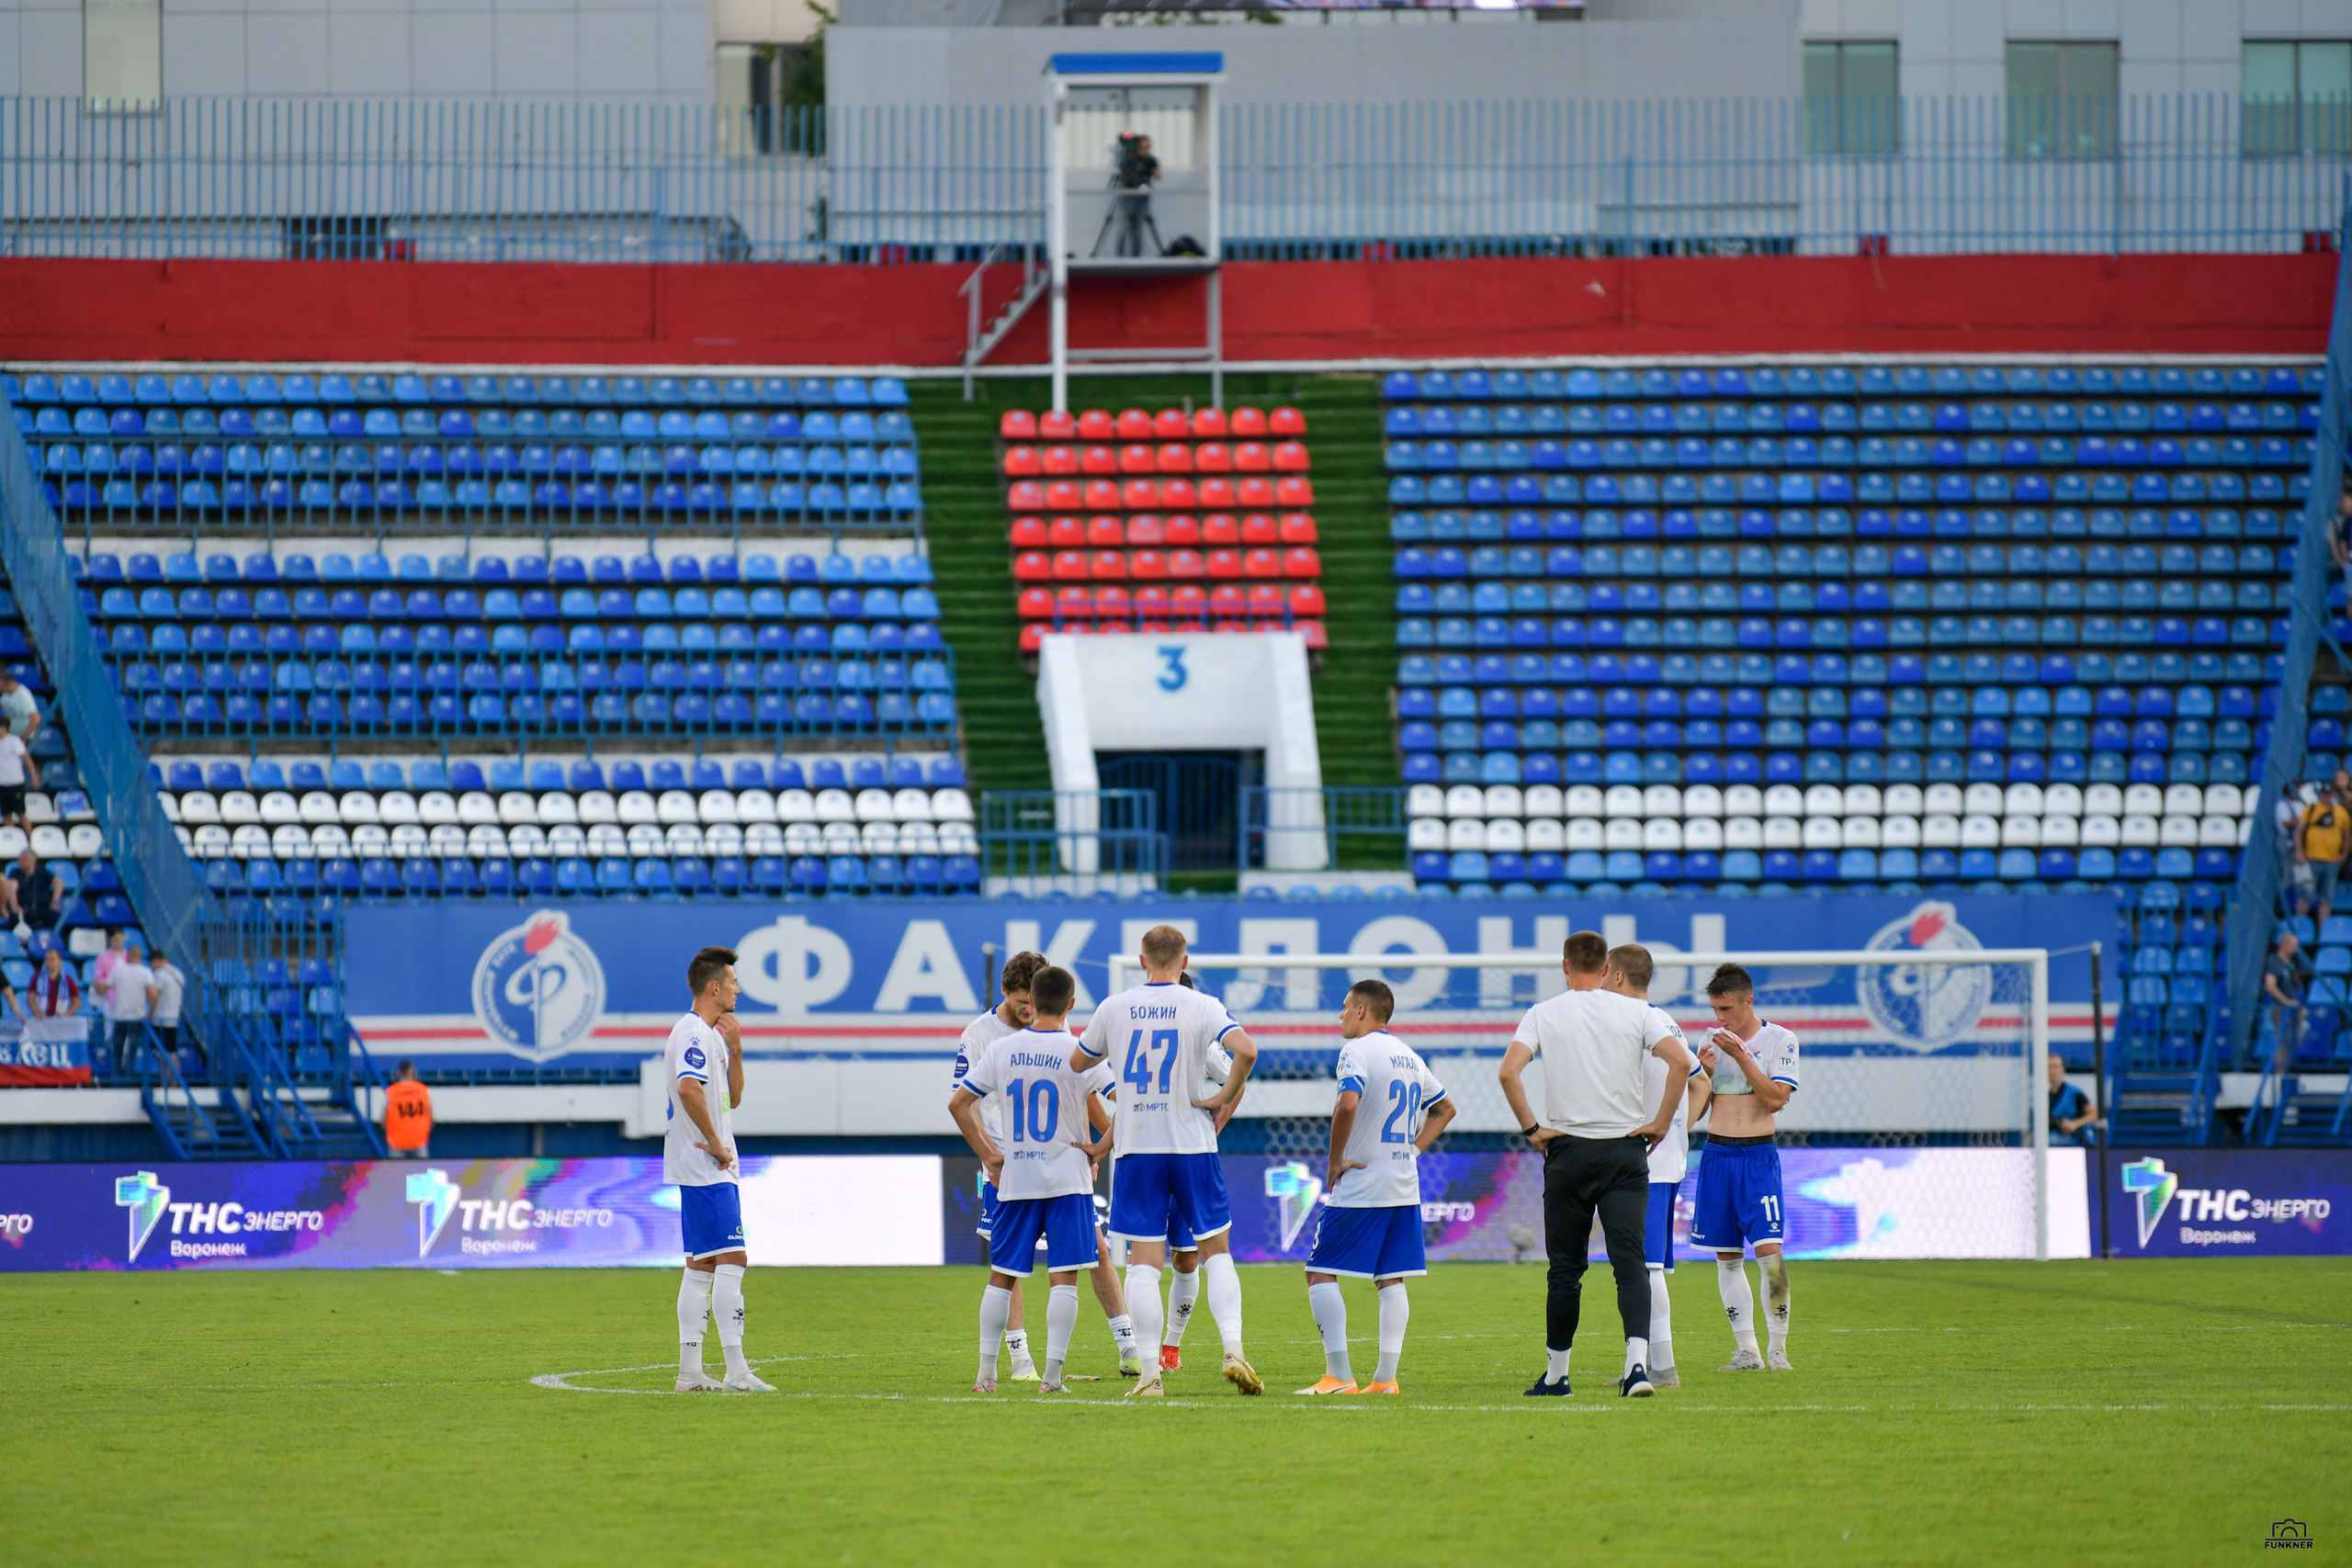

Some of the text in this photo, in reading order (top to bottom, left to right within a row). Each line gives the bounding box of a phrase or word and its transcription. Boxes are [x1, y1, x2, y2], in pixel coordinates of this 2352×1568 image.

[1158, 646, 1188, 691] 3
[1130, 1006, 1177, 1020] БОЖИН
[1011, 1053, 1062, 1070] АЛЬШИН
[1124, 1030, 1179, 1094] 47
[1006, 1078, 1059, 1143] 10
[1381, 1079, 1421, 1145] 28
[168, 1201, 324, 1235] ТНС ЭНЕРГО
[458, 1199, 614, 1231] ТНС ЭНЕРГО
[1760, 1195, 1781, 1222] 11
[2175, 1189, 2331, 1222] ТНС ЭНЕРГО
[170, 1239, 247, 1259] Воронеж
[461, 1236, 538, 1256] Воронеж
[2180, 1227, 2256, 1247] Воронеж
